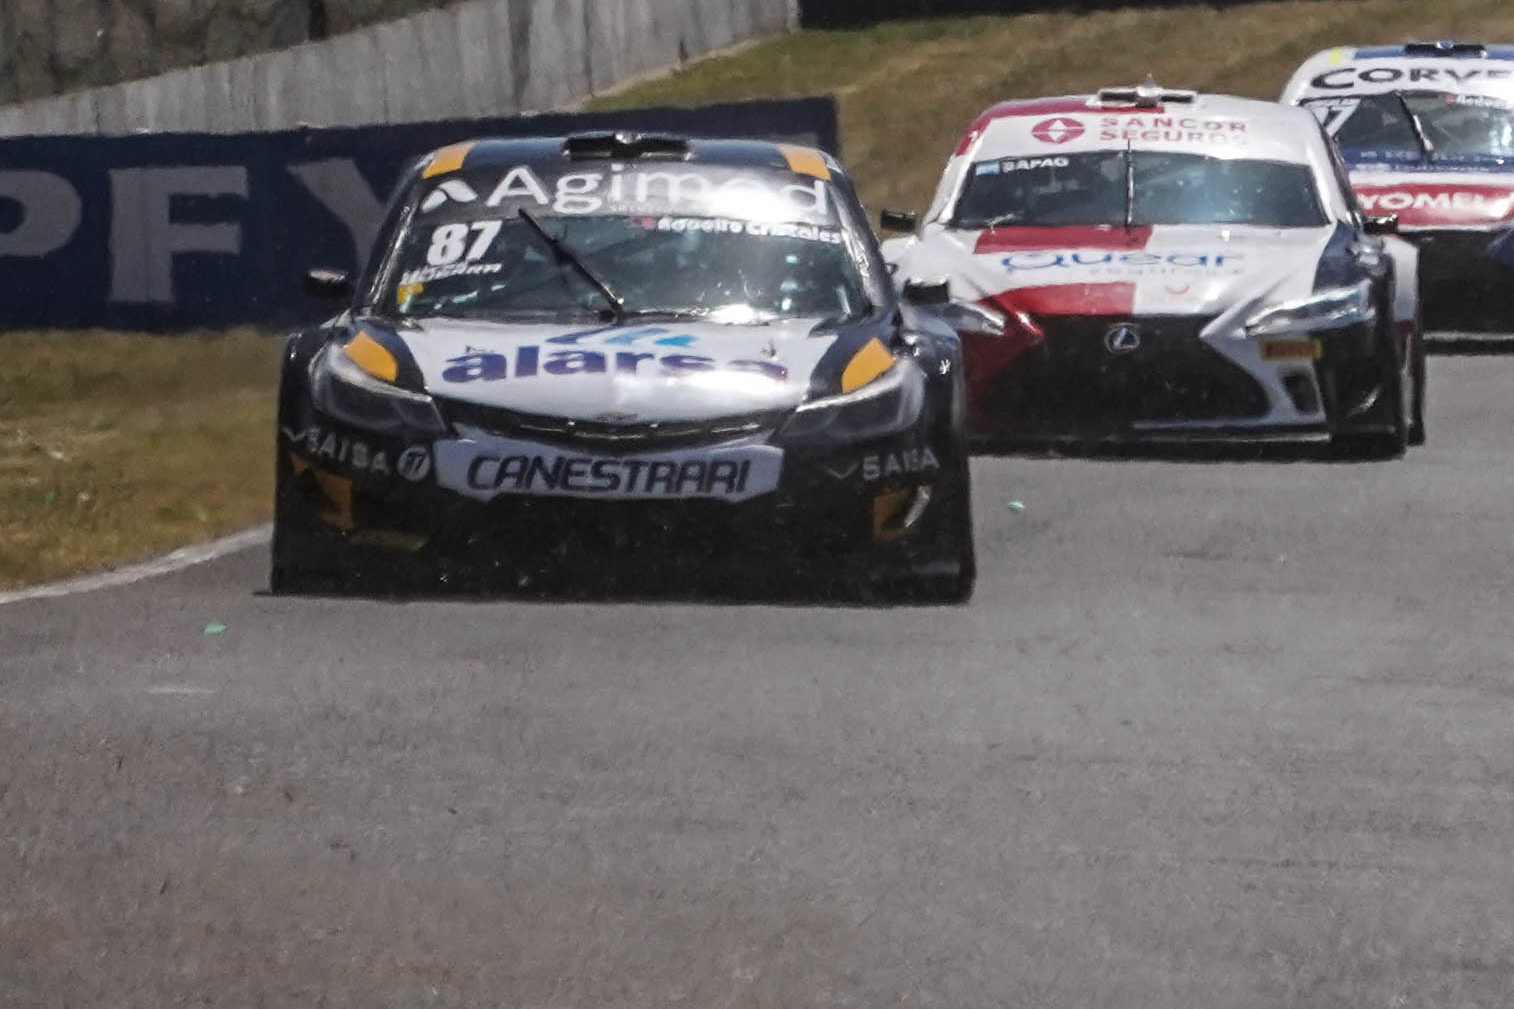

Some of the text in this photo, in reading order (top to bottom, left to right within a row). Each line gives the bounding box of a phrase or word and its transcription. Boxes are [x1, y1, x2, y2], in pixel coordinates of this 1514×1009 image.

[1100, 116, 1248, 133] SANCOR
[1100, 129, 1249, 146] SEGUROS
[427, 219, 503, 266] 87
[466, 454, 753, 493] CANESTRARI
